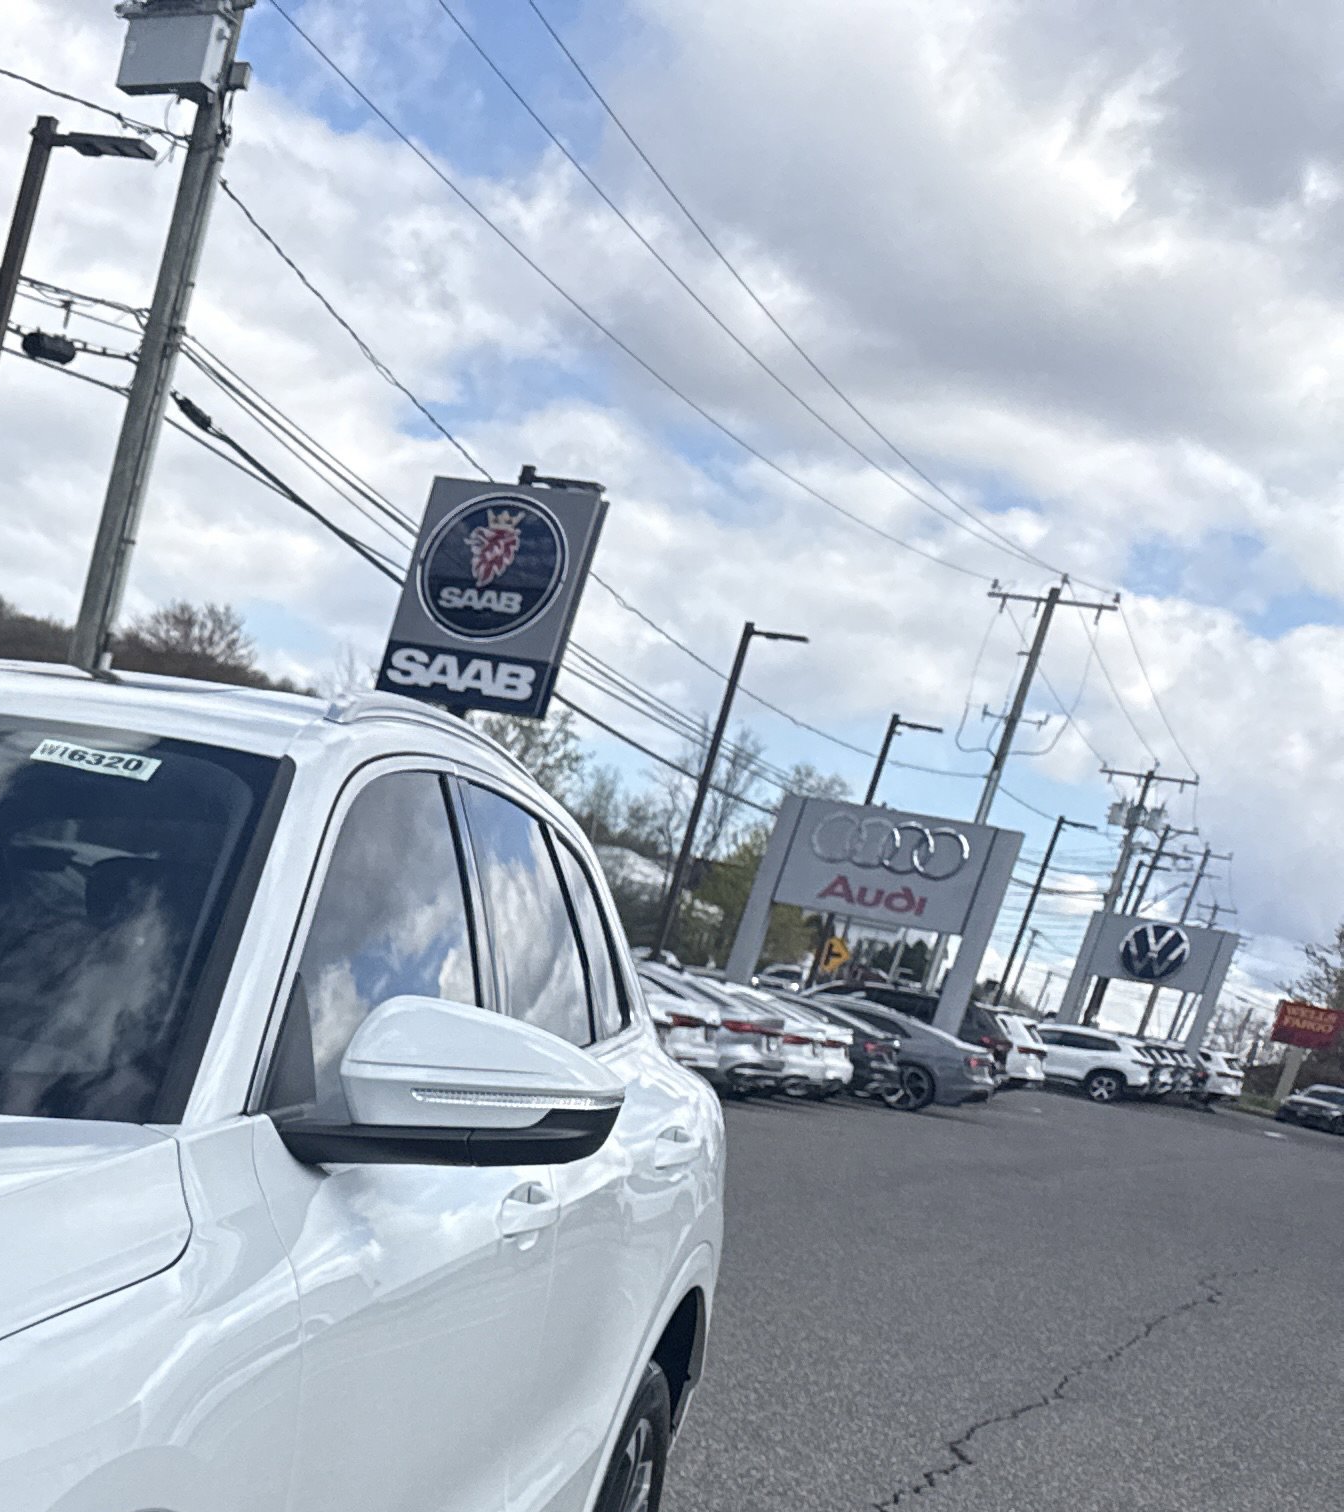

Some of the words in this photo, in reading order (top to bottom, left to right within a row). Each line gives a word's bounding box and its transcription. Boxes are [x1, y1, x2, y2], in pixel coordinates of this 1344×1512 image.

[438, 586, 523, 615] SAAB
[386, 647, 536, 701] SAAB
[815, 873, 928, 917] Audi
[1283, 1015, 1334, 1034] FARGO
